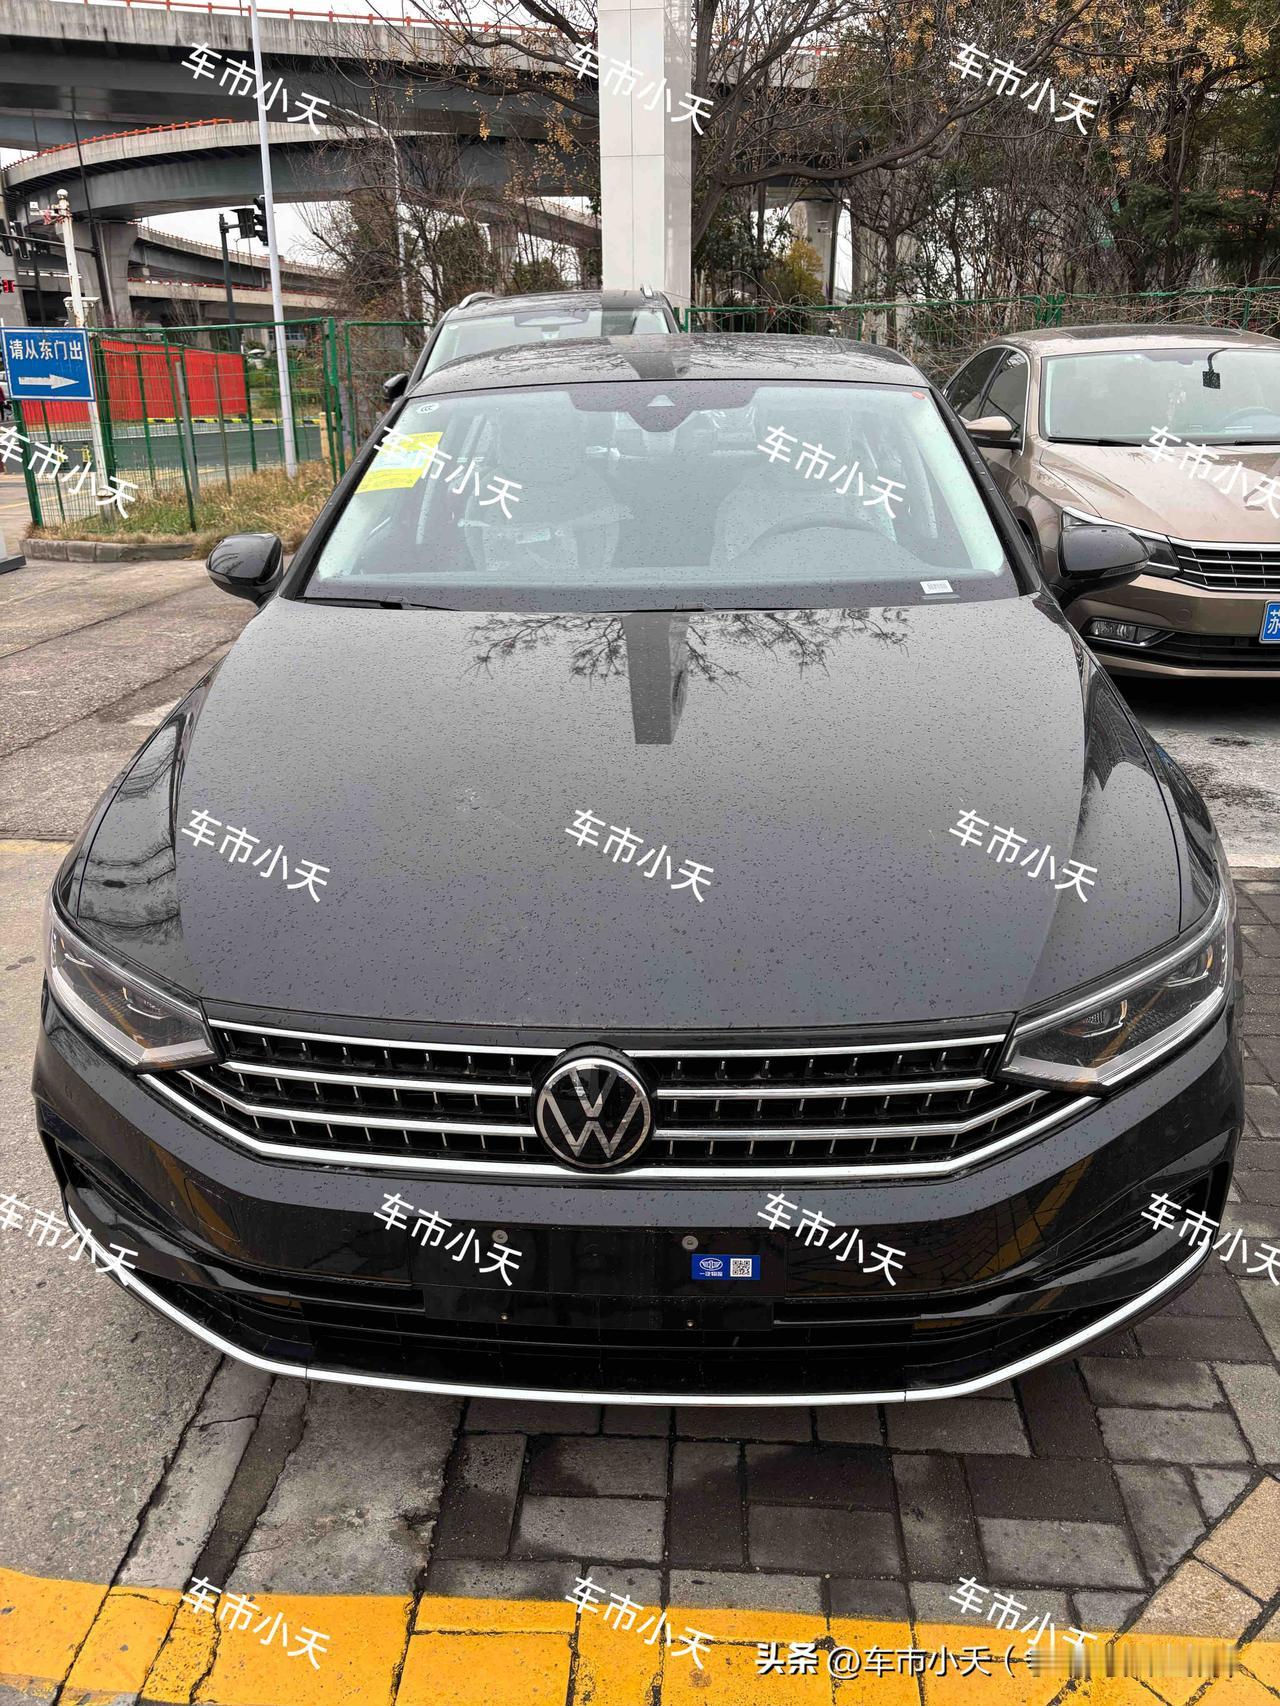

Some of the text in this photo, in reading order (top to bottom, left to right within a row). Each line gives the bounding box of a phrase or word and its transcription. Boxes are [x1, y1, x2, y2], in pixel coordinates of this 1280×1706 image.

[9, 339, 83, 360] 请从东门出
